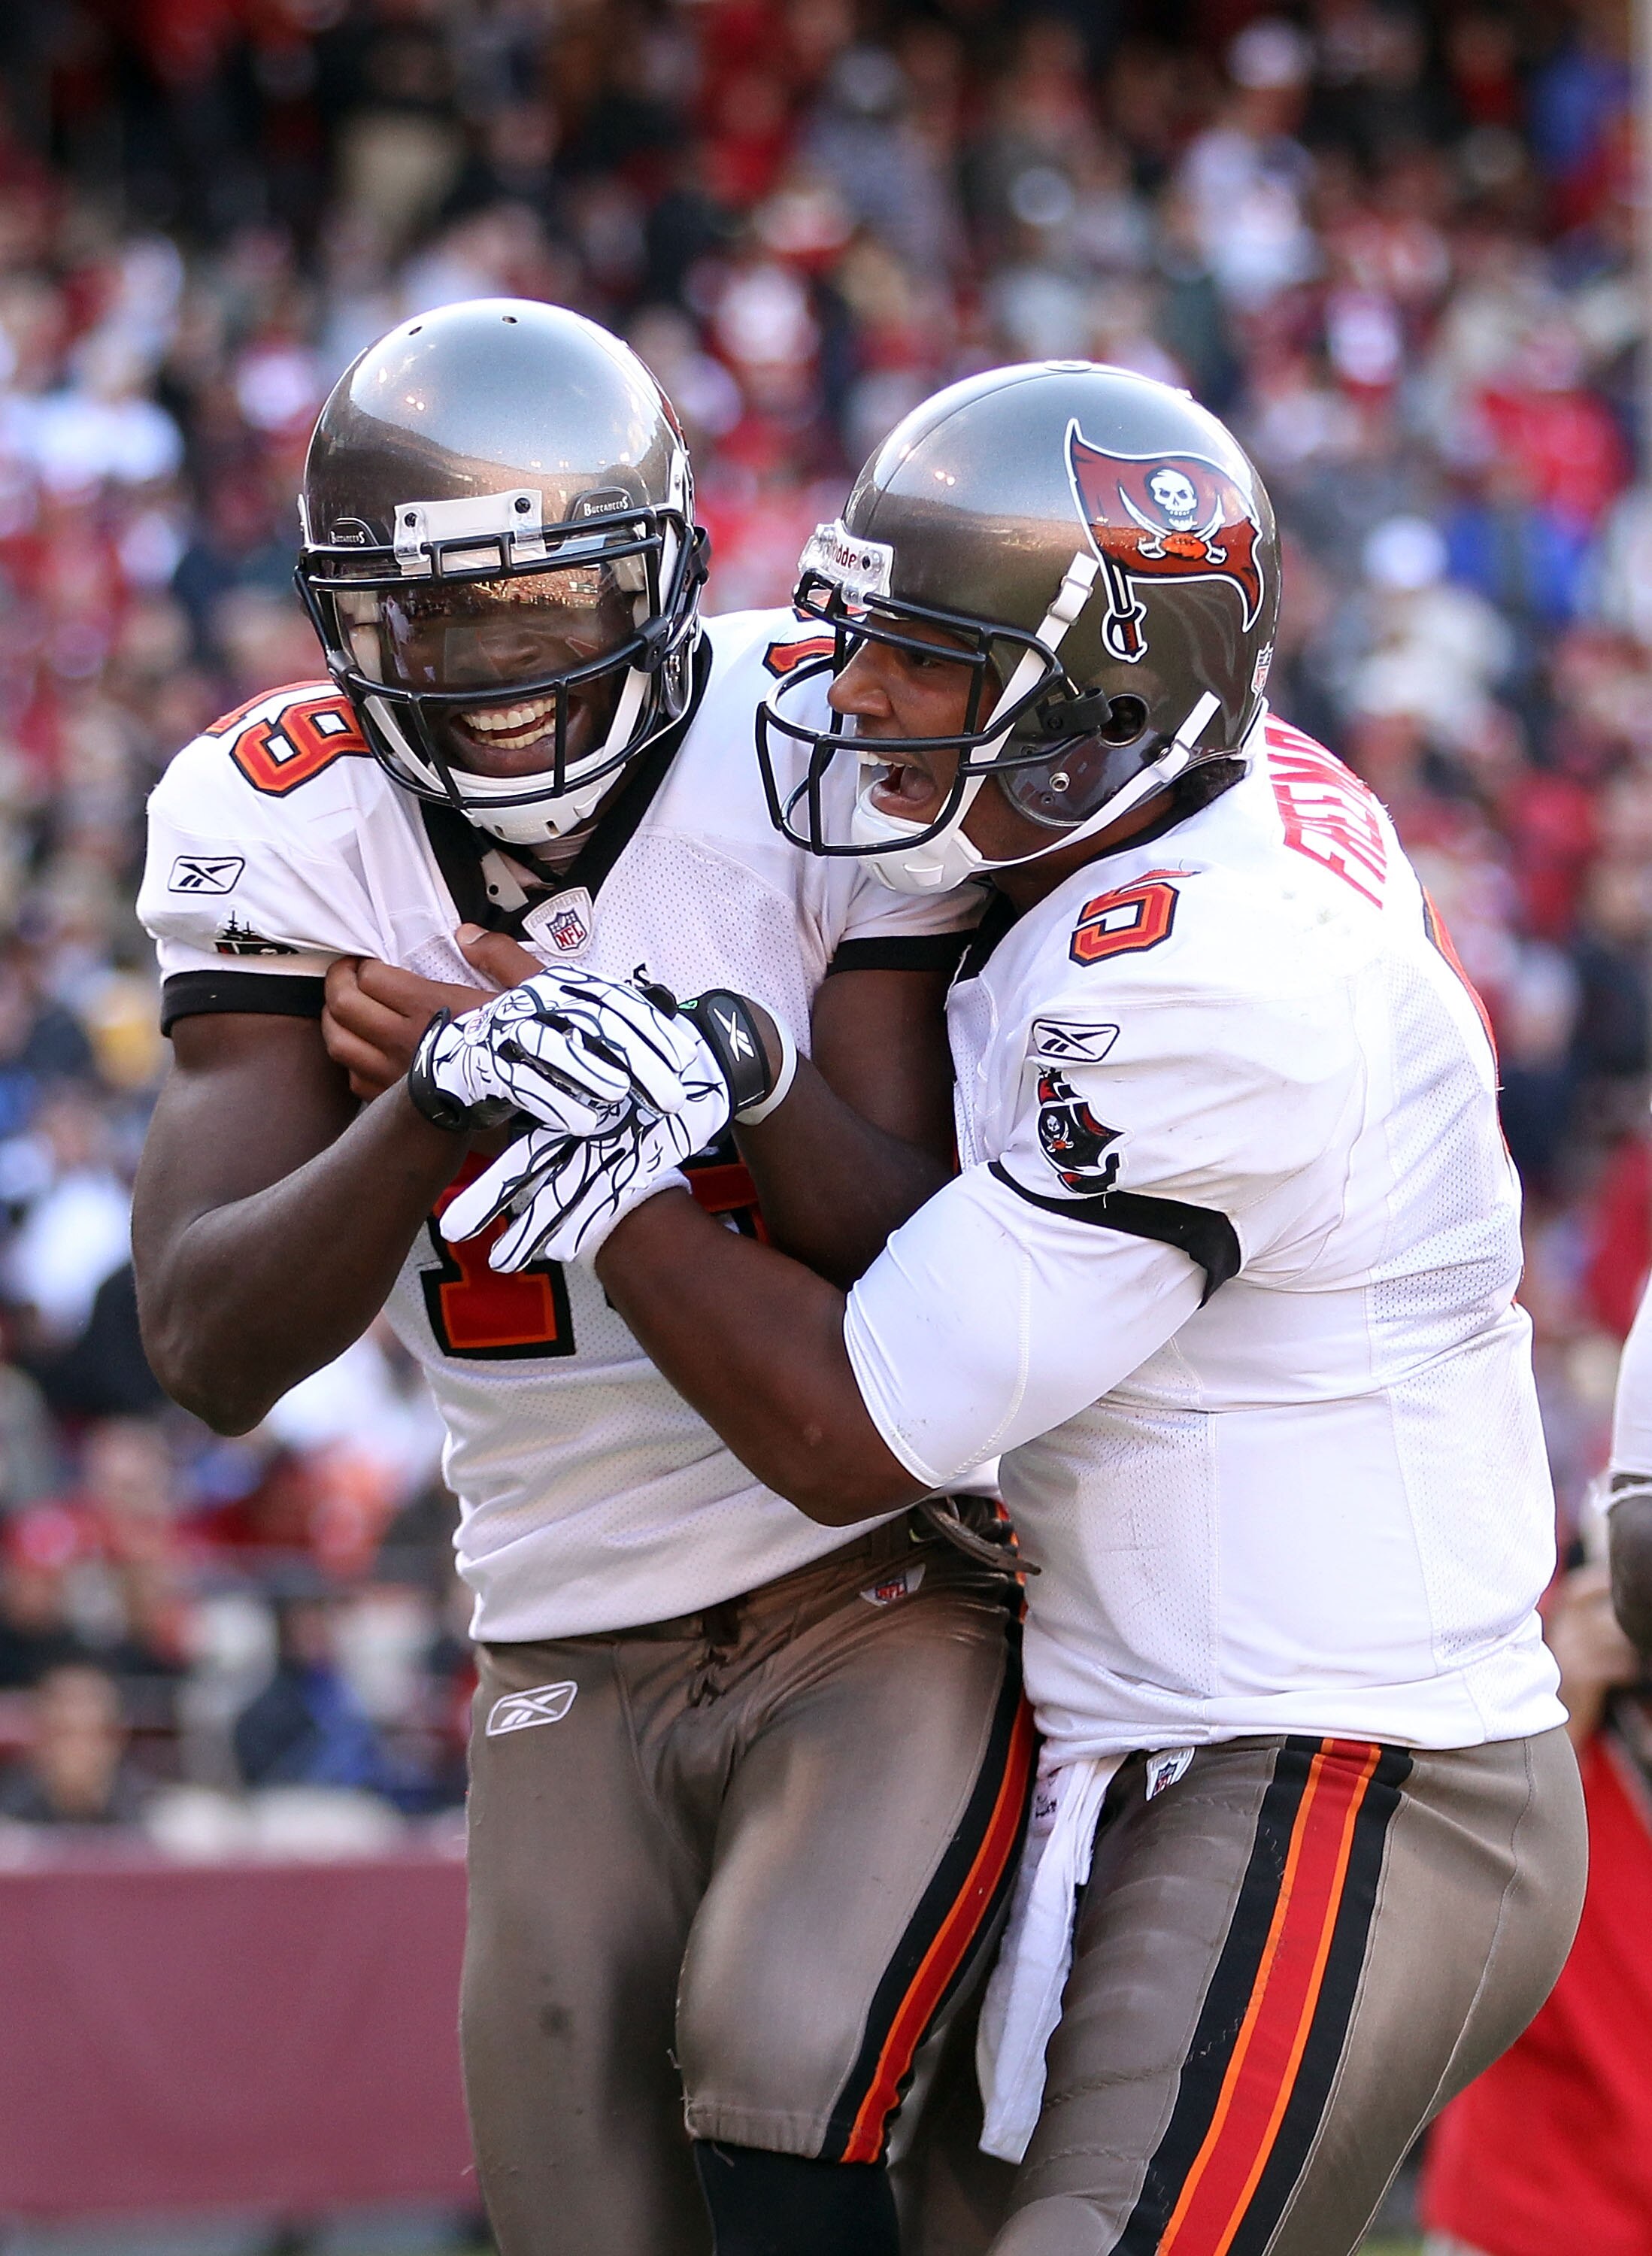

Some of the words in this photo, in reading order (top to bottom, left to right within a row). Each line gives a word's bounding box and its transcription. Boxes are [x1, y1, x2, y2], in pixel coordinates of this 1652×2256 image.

[584, 496, 629, 517] BUCCANEERS
[1265, 712, 1388, 910] FREEMA
[555, 924, 584, 948] NFL
[1068, 869, 1202, 968] 5
